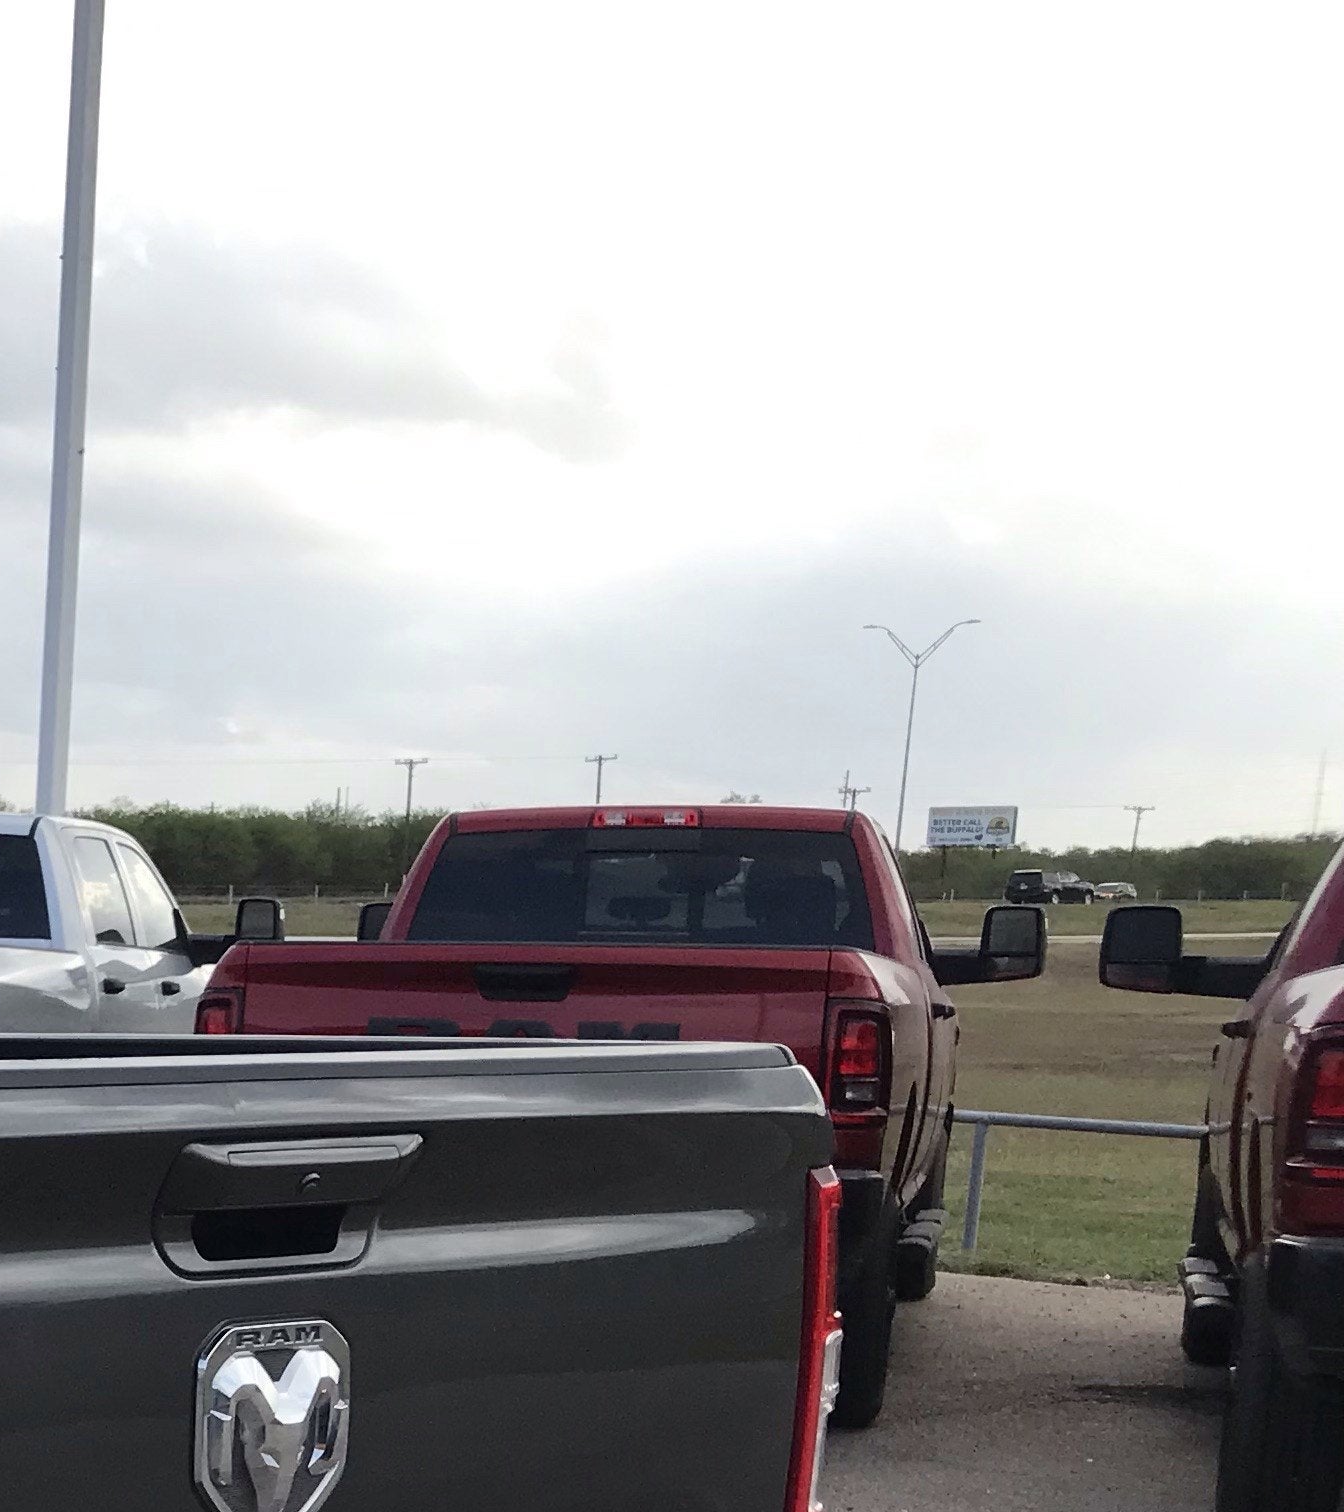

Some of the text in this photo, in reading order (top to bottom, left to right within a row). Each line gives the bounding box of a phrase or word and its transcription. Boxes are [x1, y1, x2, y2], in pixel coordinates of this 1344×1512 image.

[963, 818, 983, 826] CALL
[931, 826, 945, 834] THE
[235, 1326, 323, 1349] RAM
